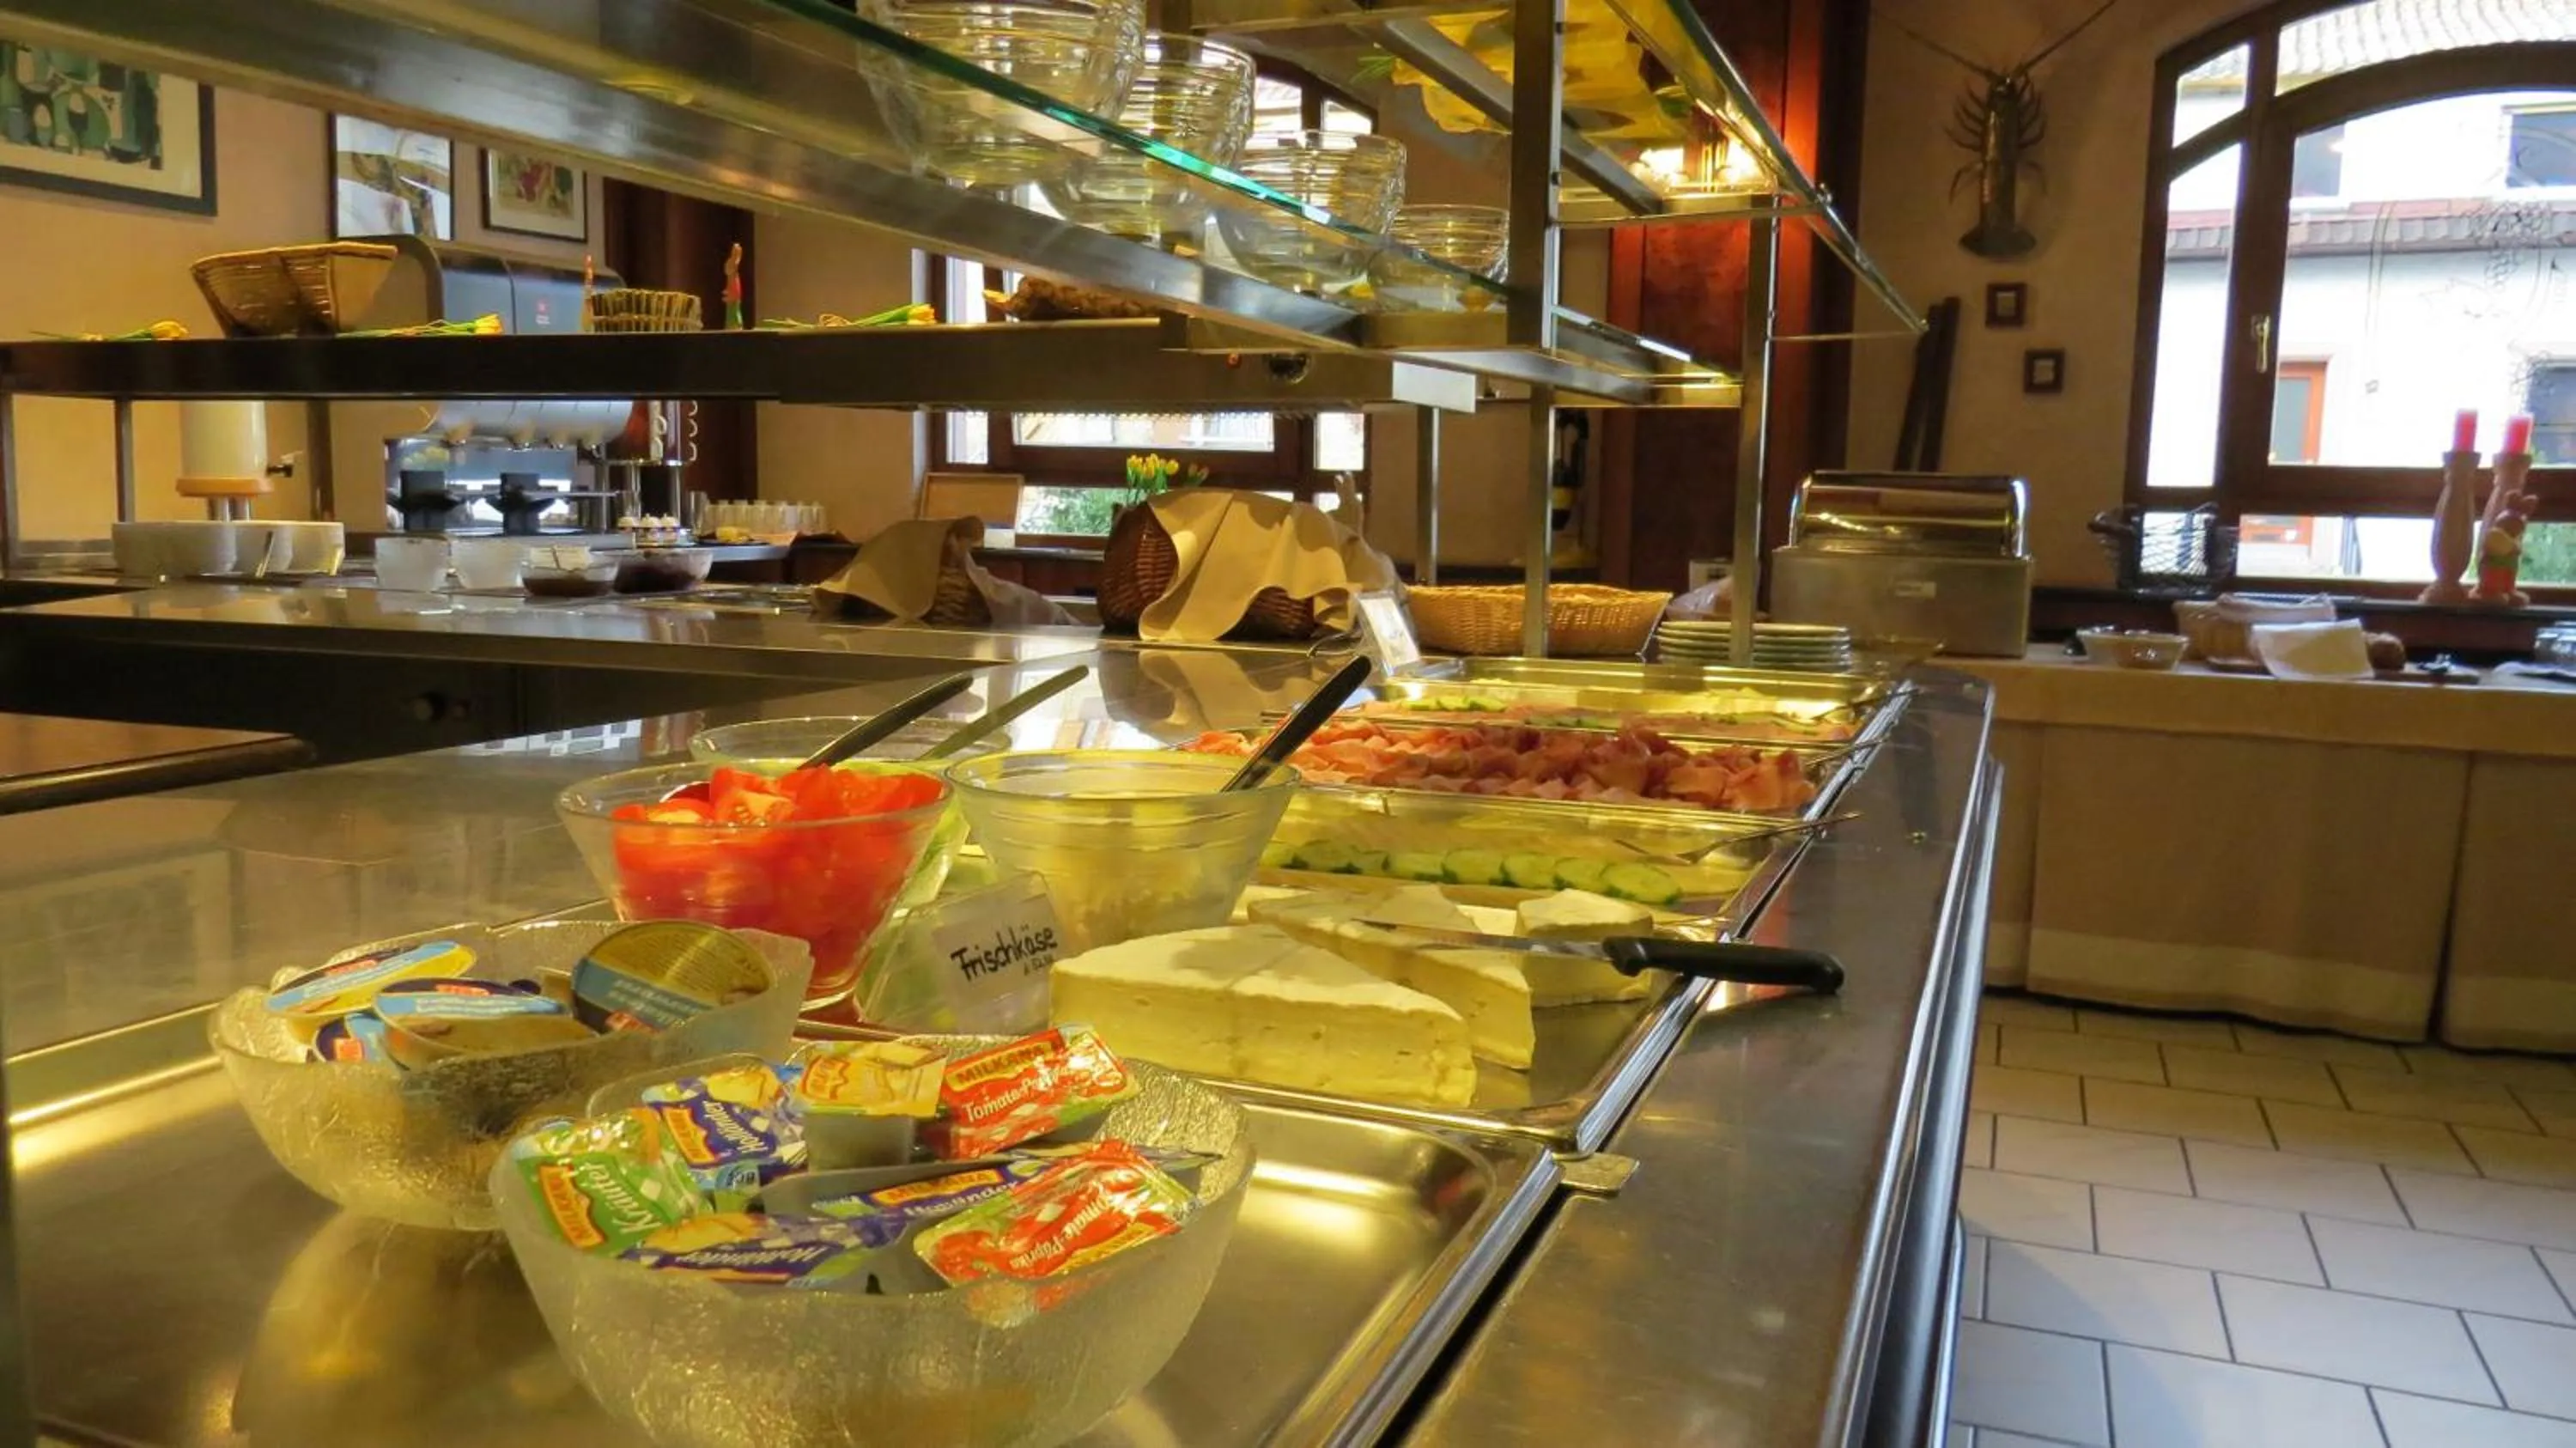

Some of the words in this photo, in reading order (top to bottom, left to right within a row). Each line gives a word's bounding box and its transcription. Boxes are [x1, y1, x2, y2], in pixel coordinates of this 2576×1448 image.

[950, 924, 1058, 982] Frischkäse
[961, 1062, 1073, 1123] Tomate-Pap
[585, 1161, 663, 1234] Kräuter
